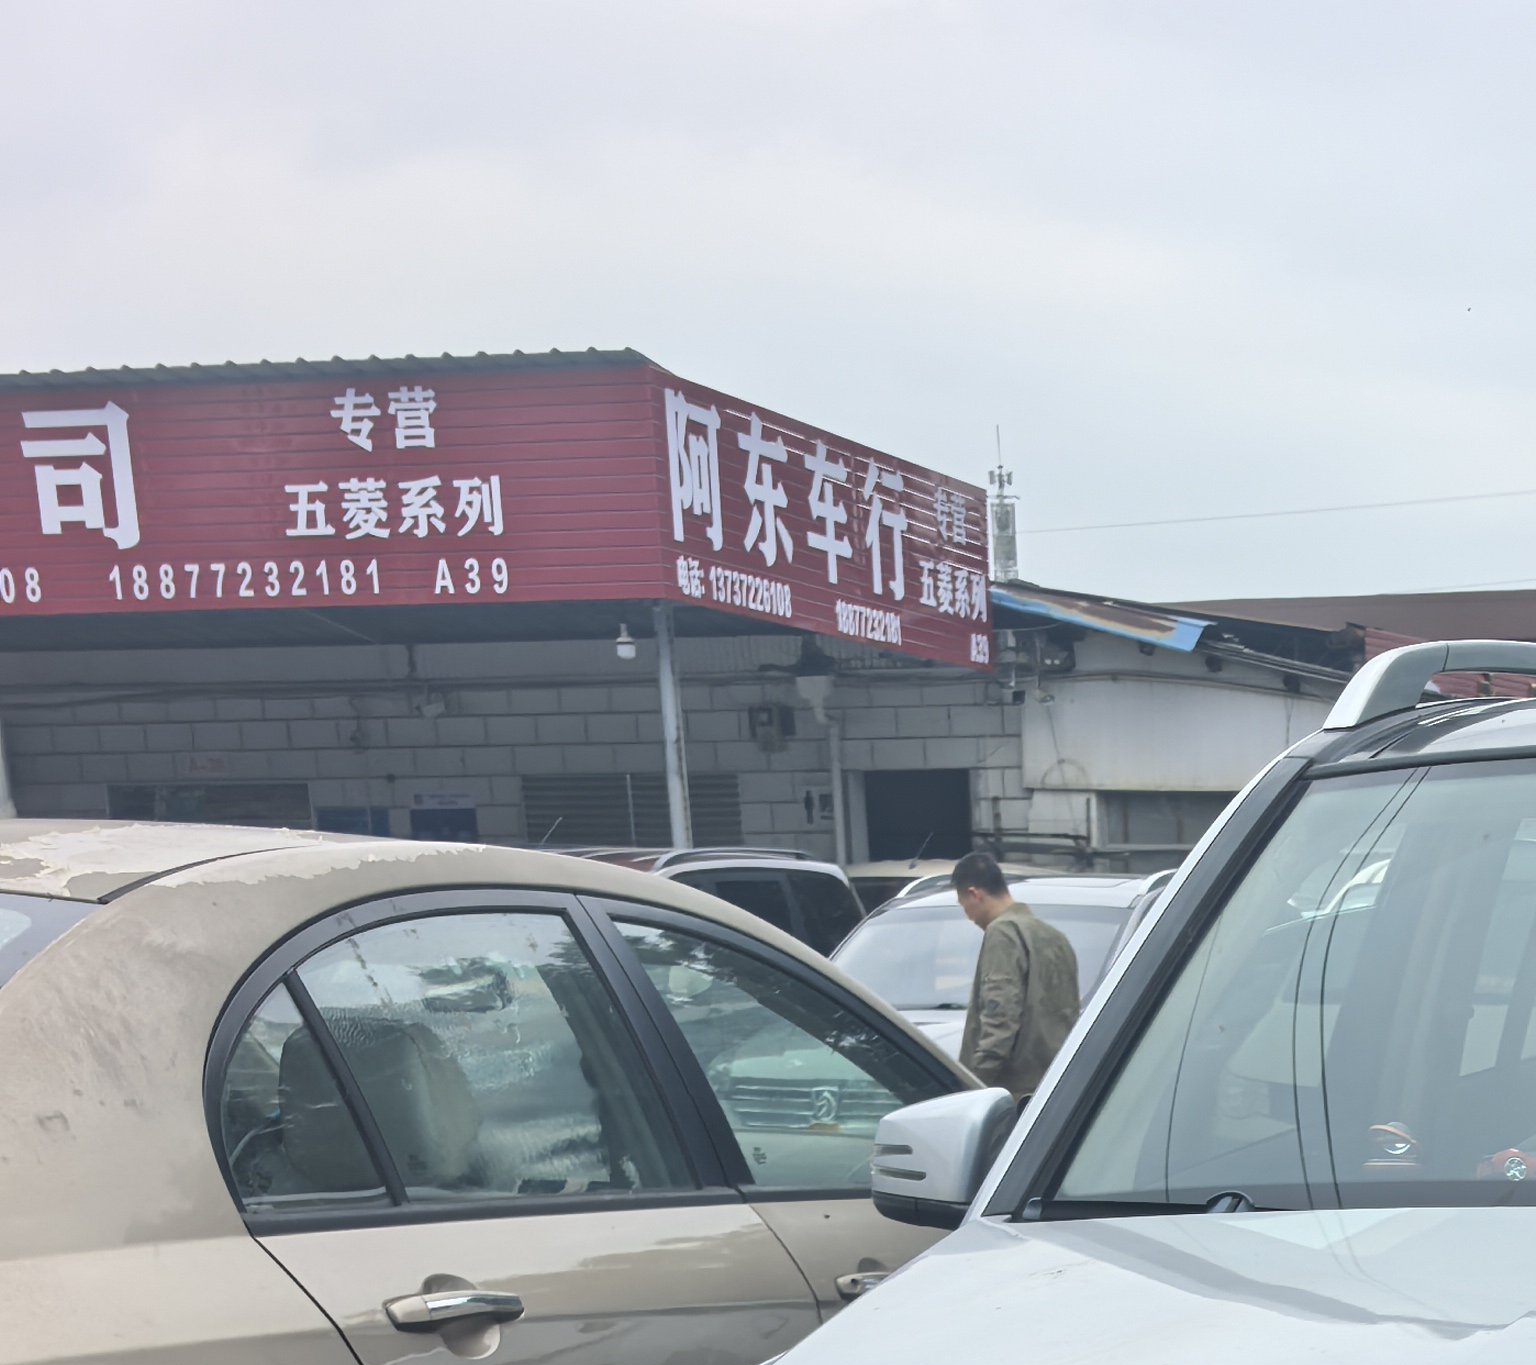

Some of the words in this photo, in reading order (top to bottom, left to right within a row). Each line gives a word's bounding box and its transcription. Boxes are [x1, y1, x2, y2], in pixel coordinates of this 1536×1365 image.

[329, 385, 438, 453] 专营
[20, 399, 142, 551] 司
[283, 473, 505, 541] 五菱系列
[664, 387, 908, 602] 阿东车行
[932, 486, 968, 546] 专营
[108, 557, 380, 601] 18877232181
[433, 557, 509, 595] A39
[708, 565, 793, 618] 13737226108
[918, 559, 988, 623] 五菱系列
